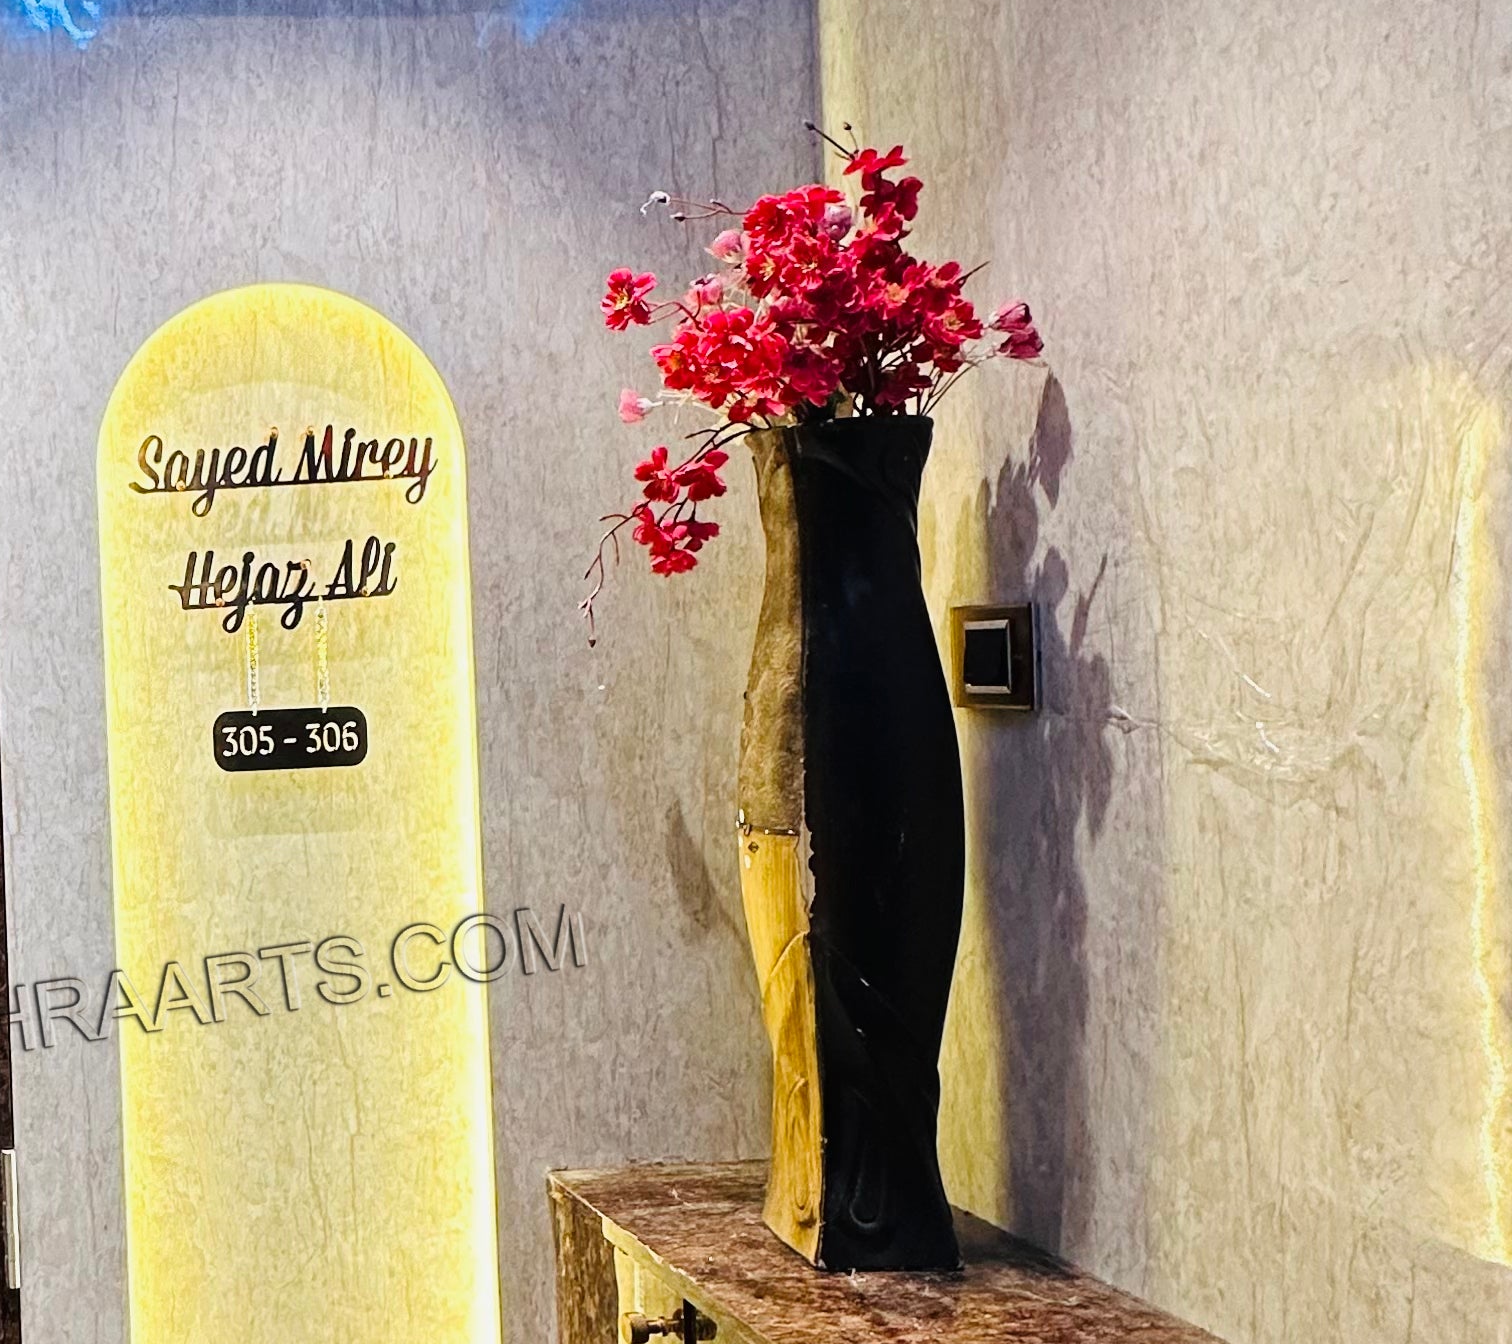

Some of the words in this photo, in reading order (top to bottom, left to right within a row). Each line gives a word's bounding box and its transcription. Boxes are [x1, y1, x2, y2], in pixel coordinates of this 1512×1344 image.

[168, 550, 315, 633] Hejaz
[325, 536, 398, 598] Ali
[221, 725, 275, 757] 305
[305, 721, 359, 754] 306
